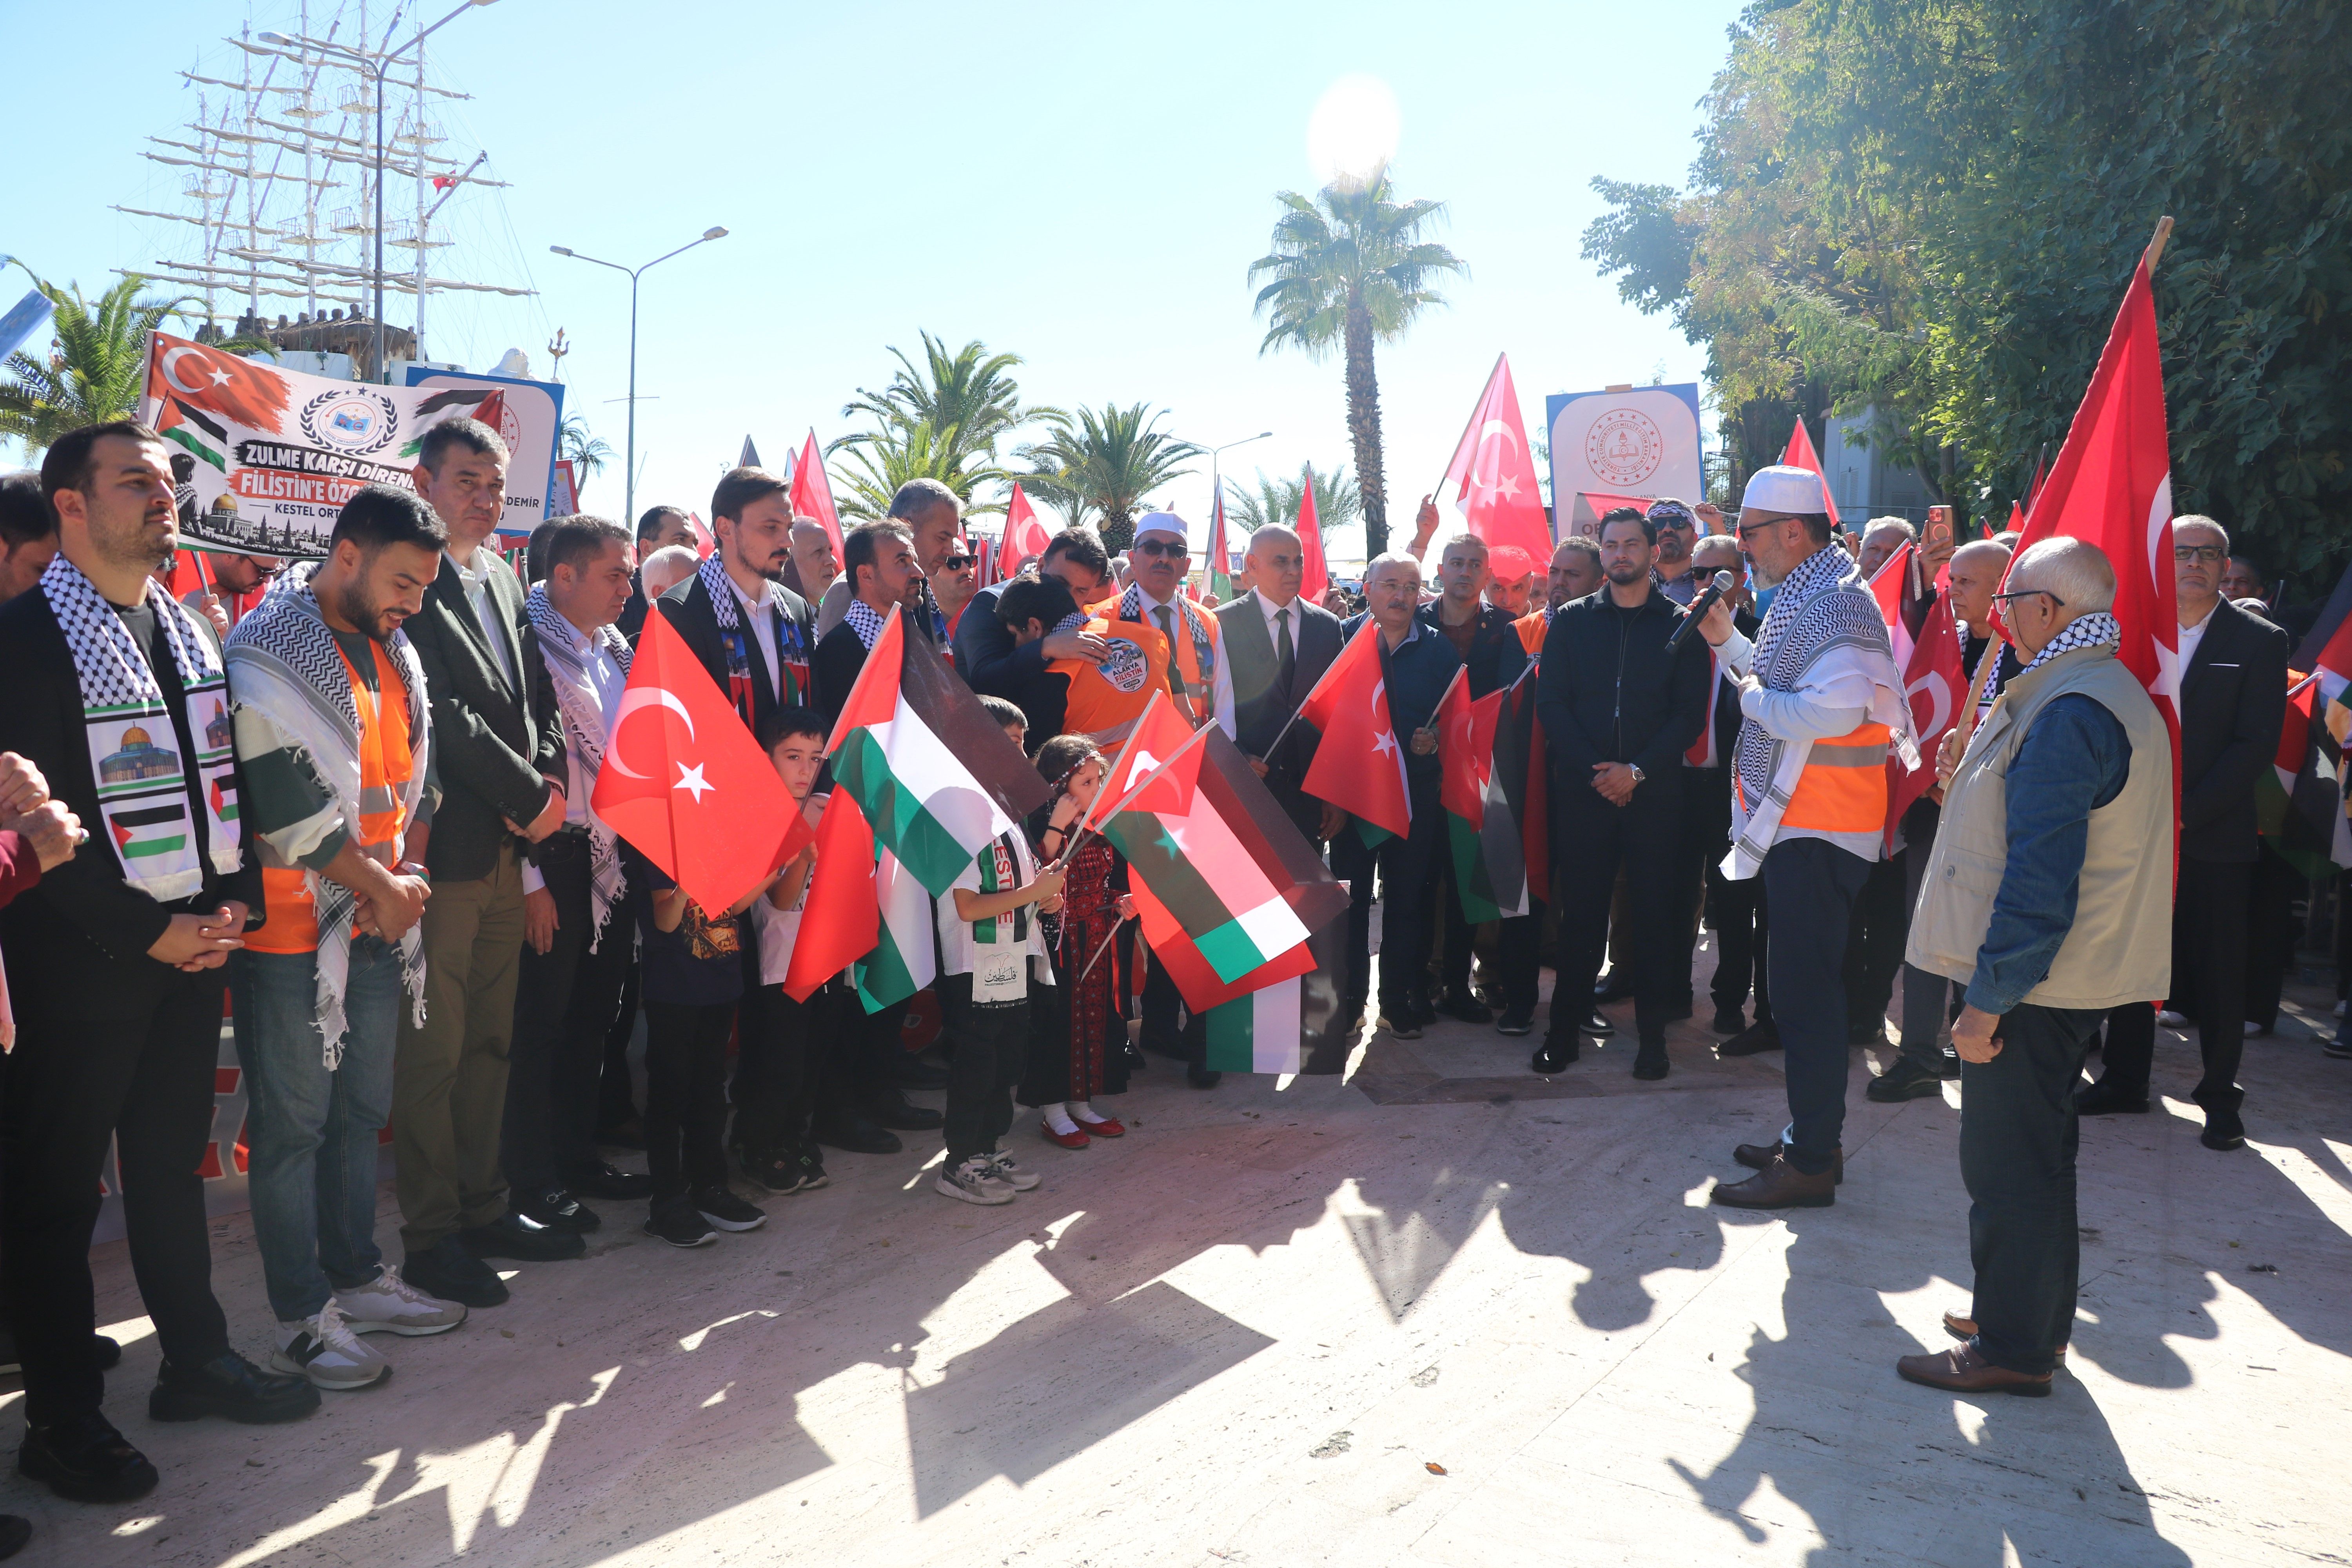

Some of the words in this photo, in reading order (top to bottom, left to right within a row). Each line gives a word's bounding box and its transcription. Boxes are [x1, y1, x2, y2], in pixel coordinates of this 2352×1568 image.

[246, 444, 301, 469] ZULME
[303, 452, 358, 477] KARŞI
[241, 470, 325, 501] FİLİSTİN'E
[328, 478, 360, 503] ÖZG
[275, 503, 315, 517] KESTEL
[318, 508, 340, 519] ORT
[1113, 662, 1140, 676] ALANYA
[1114, 667, 1143, 682] FİLİSTİN
